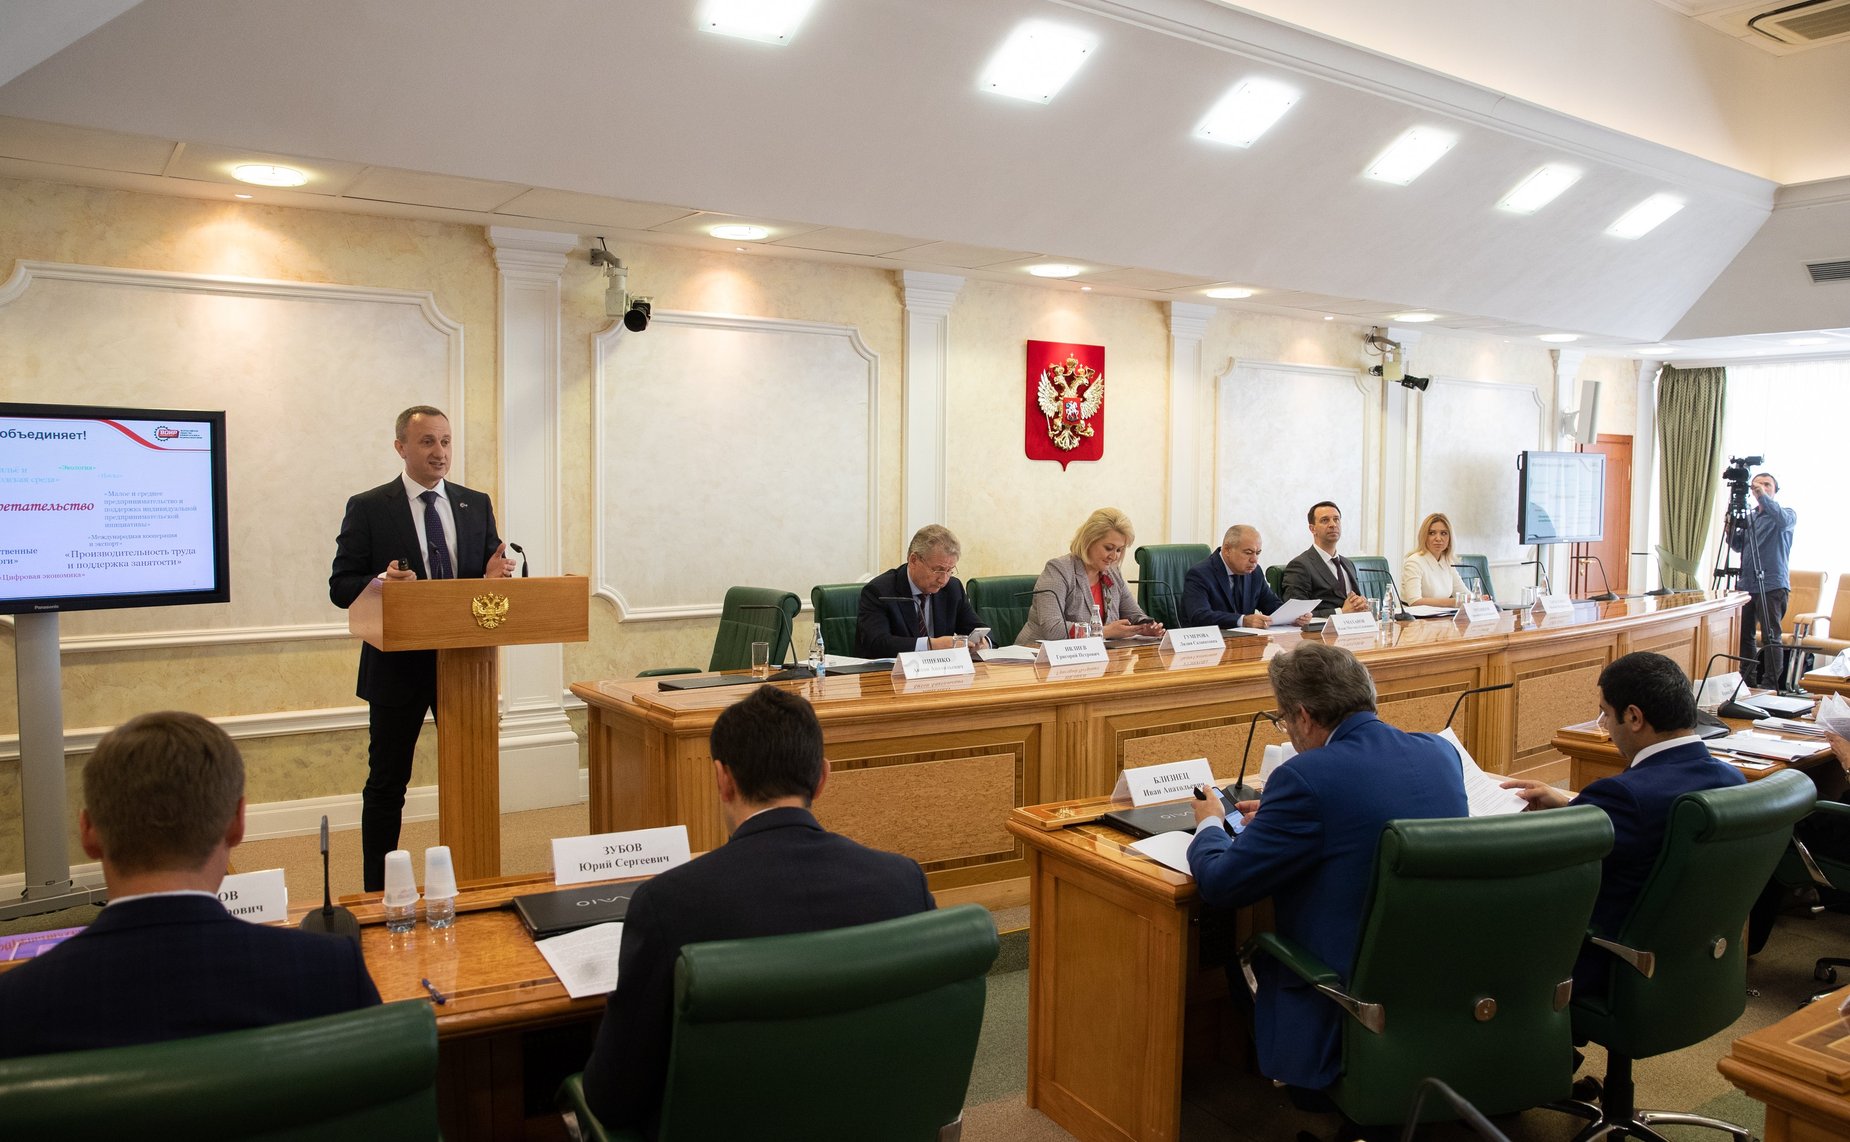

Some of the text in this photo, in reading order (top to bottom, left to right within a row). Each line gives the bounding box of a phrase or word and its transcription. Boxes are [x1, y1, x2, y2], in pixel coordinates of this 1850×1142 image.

[0, 428, 87, 441] объединяет!
[171, 548, 196, 557] труда
[1153, 772, 1190, 784] БЛИЗНЕЦ
[1143, 788, 1162, 797] Иван
[603, 842, 643, 856] ЗУБОВ
[579, 854, 670, 872] Юрий Сергеевич
